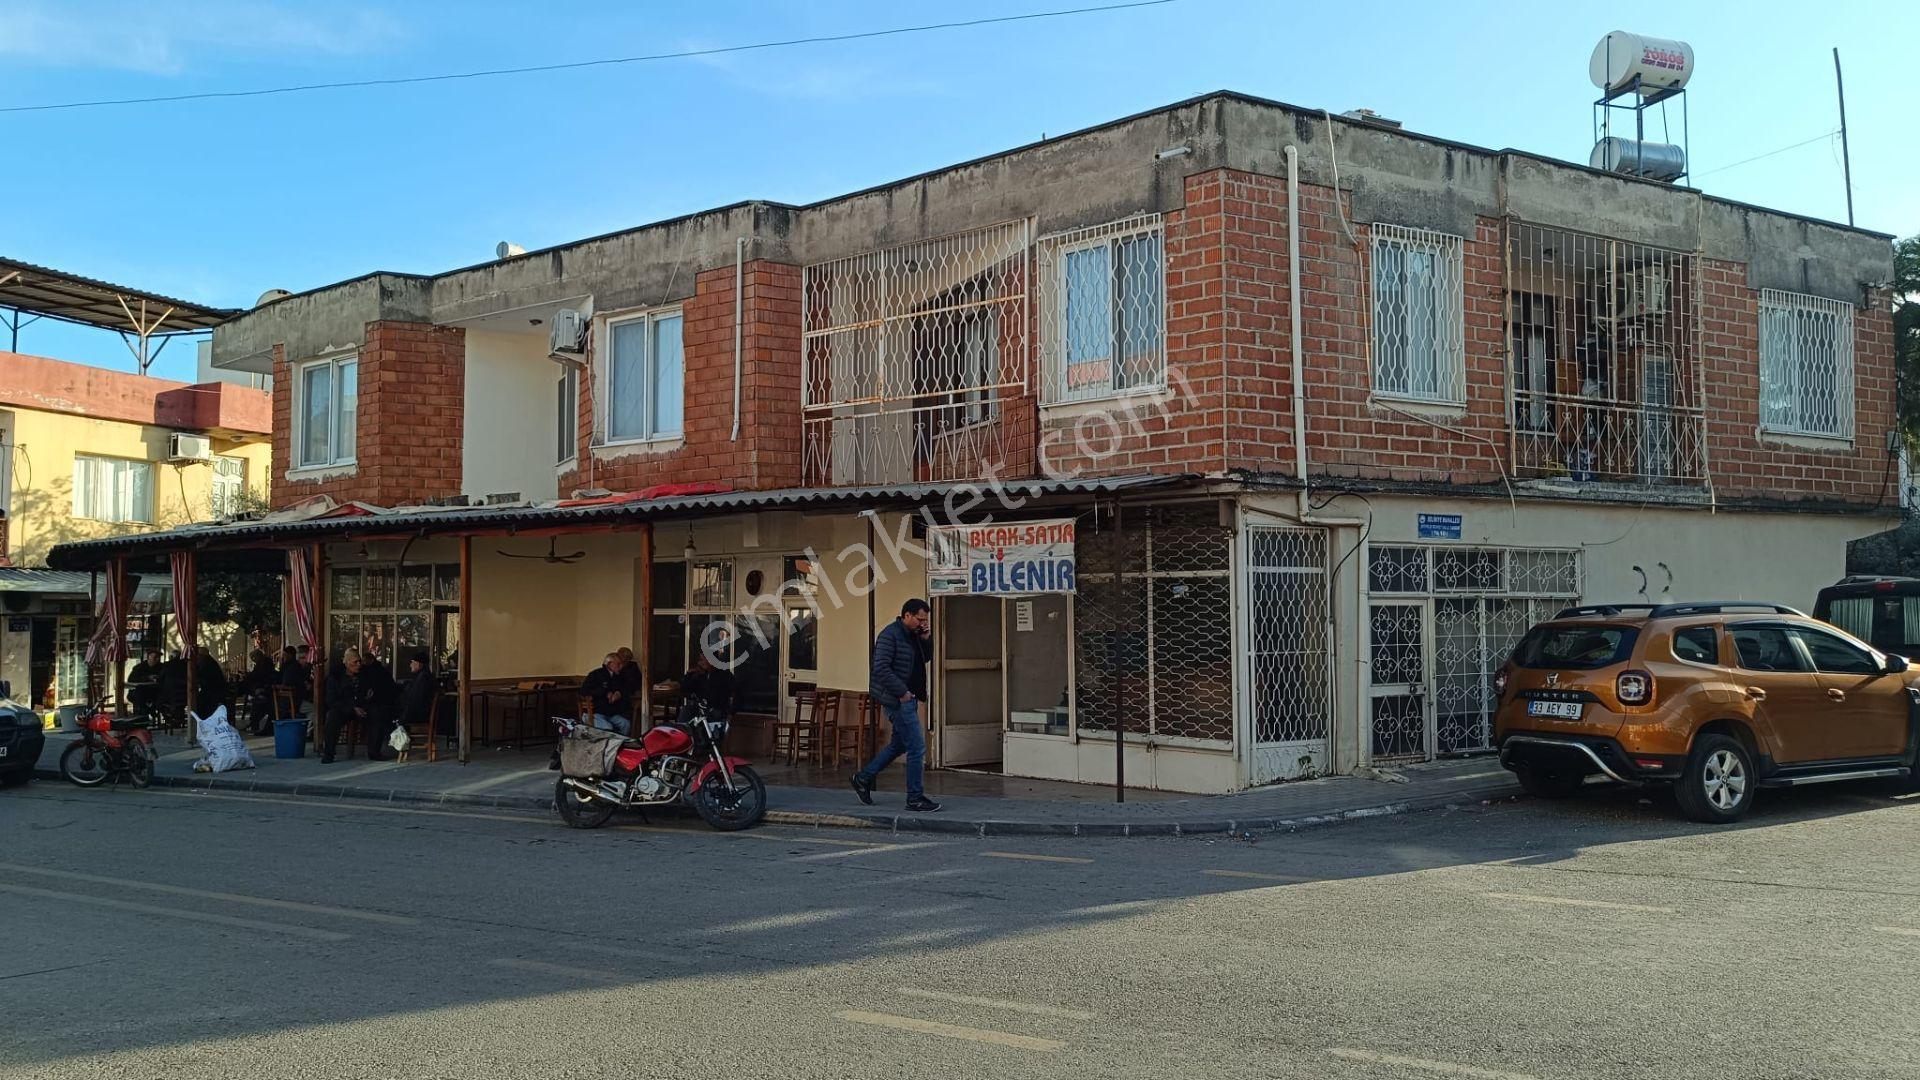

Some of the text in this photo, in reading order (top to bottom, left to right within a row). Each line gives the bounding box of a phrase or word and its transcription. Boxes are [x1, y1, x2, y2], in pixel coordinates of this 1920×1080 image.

[971, 551, 1074, 592] BİLENİR
[1533, 703, 1577, 715] 33 AEY 99
